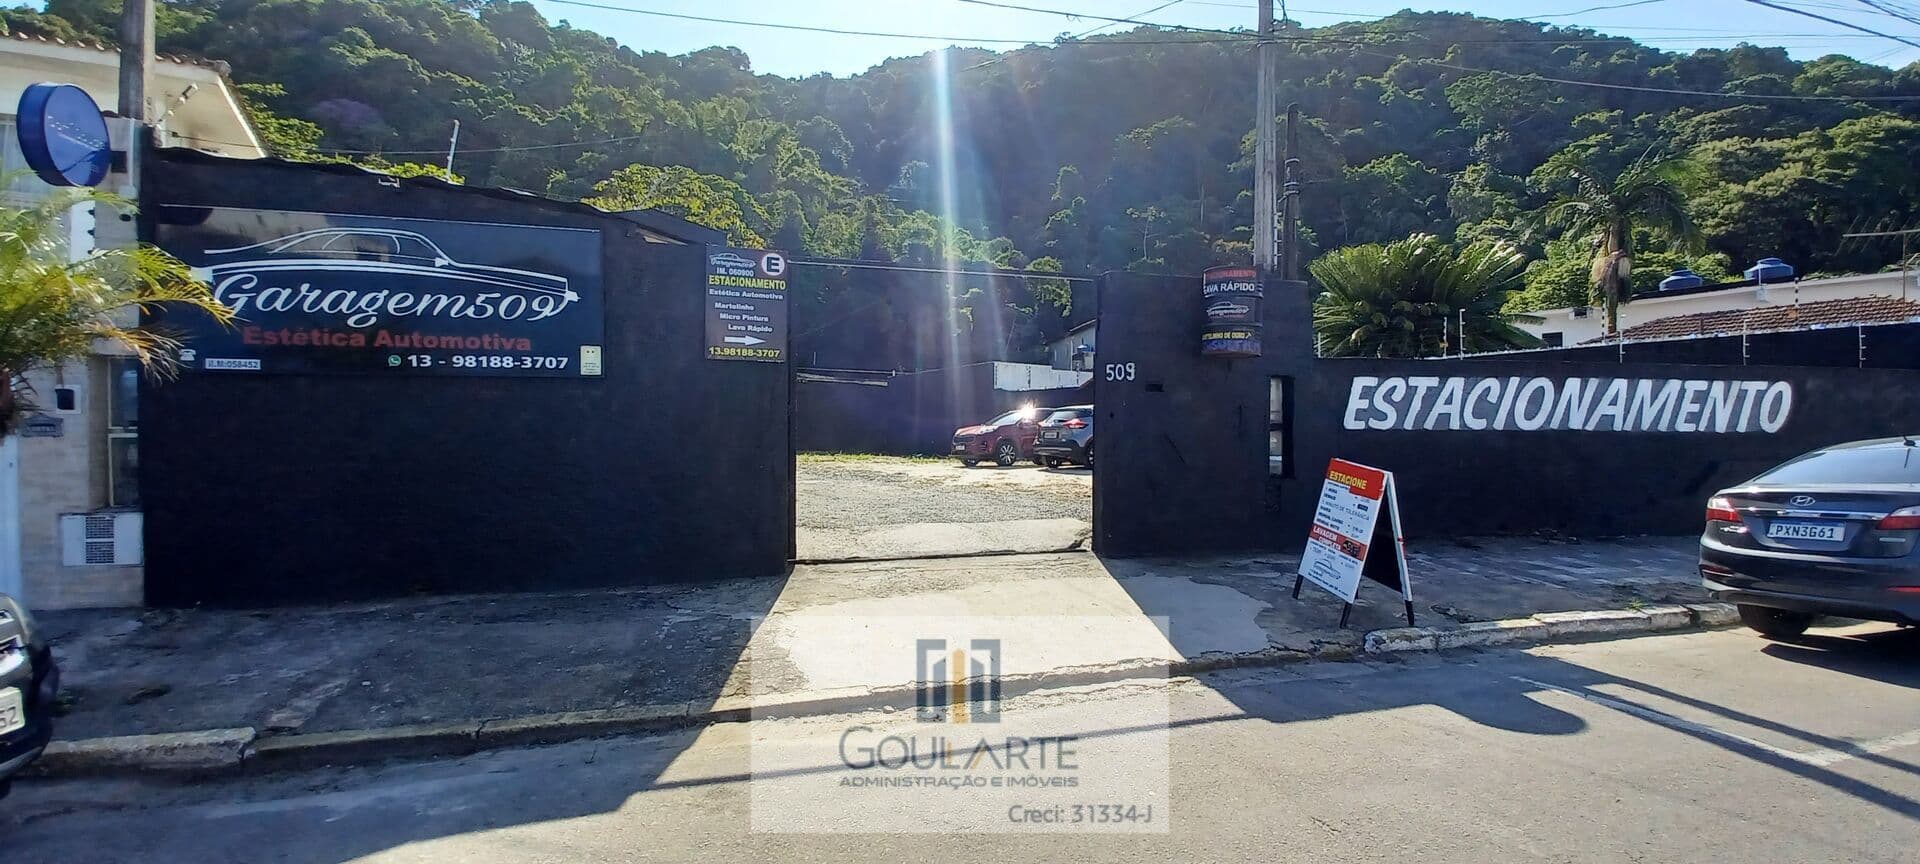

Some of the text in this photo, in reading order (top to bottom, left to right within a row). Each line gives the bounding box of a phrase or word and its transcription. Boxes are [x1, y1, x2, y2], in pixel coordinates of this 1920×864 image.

[766, 256, 780, 273] E
[709, 275, 786, 290] ESTACIONAMENTO
[1220, 281, 1255, 292] RÁPIDO
[213, 272, 569, 328] Garagem509
[709, 289, 783, 300] Estética Automotiva
[714, 302, 754, 311] Martelinho
[742, 314, 769, 322] Pintura
[747, 325, 773, 333] Rápido
[242, 326, 531, 351] Estética Automotiva
[709, 346, 780, 358] 13.98188-3707
[407, 355, 432, 368] 13
[452, 354, 569, 370] 98188-3707
[1105, 362, 1136, 382] 509
[1343, 376, 1792, 434] ESTACIONAMENTO
[1329, 470, 1368, 490] ESTACIONE
[1312, 525, 1338, 542] LAVAGEM
[1775, 524, 1835, 539] PXN3G61
